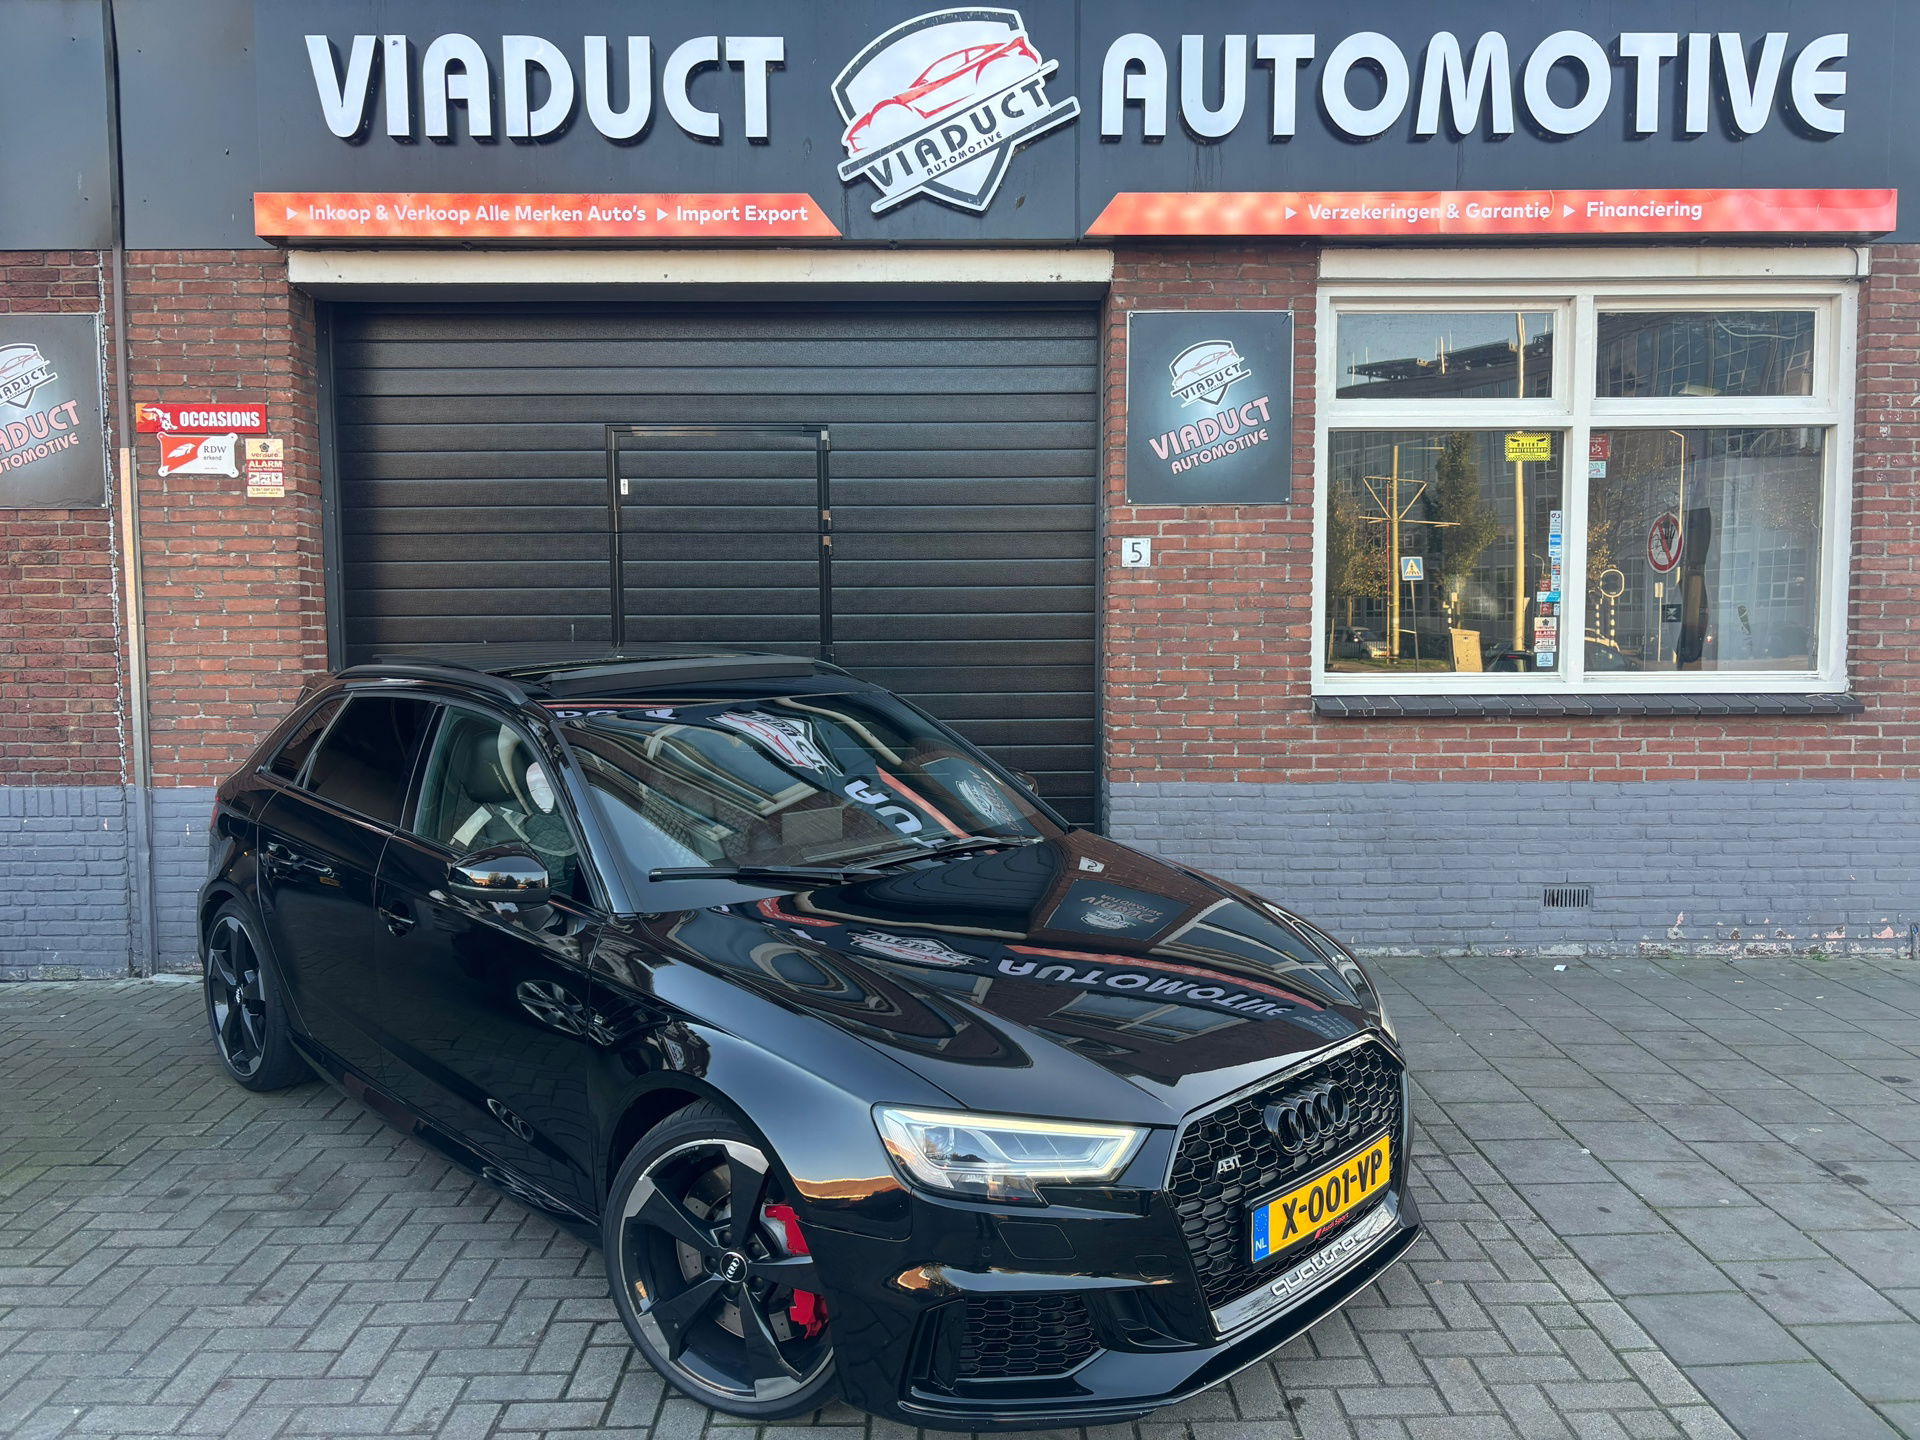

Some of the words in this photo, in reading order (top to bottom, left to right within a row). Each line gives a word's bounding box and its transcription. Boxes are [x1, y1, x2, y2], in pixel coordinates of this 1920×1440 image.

[304, 32, 785, 139] VIADUCT
[1100, 30, 1848, 138] AUTOMOTIVE
[867, 79, 1048, 187] VIADUCT
[926, 131, 1003, 176] AUTOMOTIVE
[309, 204, 371, 224] Inkoop
[375, 204, 389, 221] &
[394, 204, 470, 224] Verkoop
[475, 204, 510, 221] Alle
[515, 204, 582, 221] Merken
[588, 204, 646, 221] Auto's
[677, 205, 740, 224] Import
[745, 205, 808, 224] Export
[1308, 203, 1440, 223] Verzekeringen
[1446, 203, 1460, 219] &
[1466, 202, 1550, 219] Garantie
[1587, 201, 1702, 221] Financiering
[1180, 363, 1242, 400] VIADUCT
[180, 411, 260, 427] OCCASIONS
[1149, 396, 1271, 460] VIADUCT
[203, 445, 227, 454] RDW
[1171, 428, 1269, 475] AUTOMOTIVE
[1130, 542, 1142, 563] 5
[1217, 1154, 1241, 1174] ABT
[1281, 1149, 1382, 1239] X-001-VP
[1321, 1220, 1335, 1233] Audi
[1334, 1212, 1349, 1225] Sport
[1255, 1237, 1267, 1251] NL
[1271, 1235, 1357, 1296] quattro
